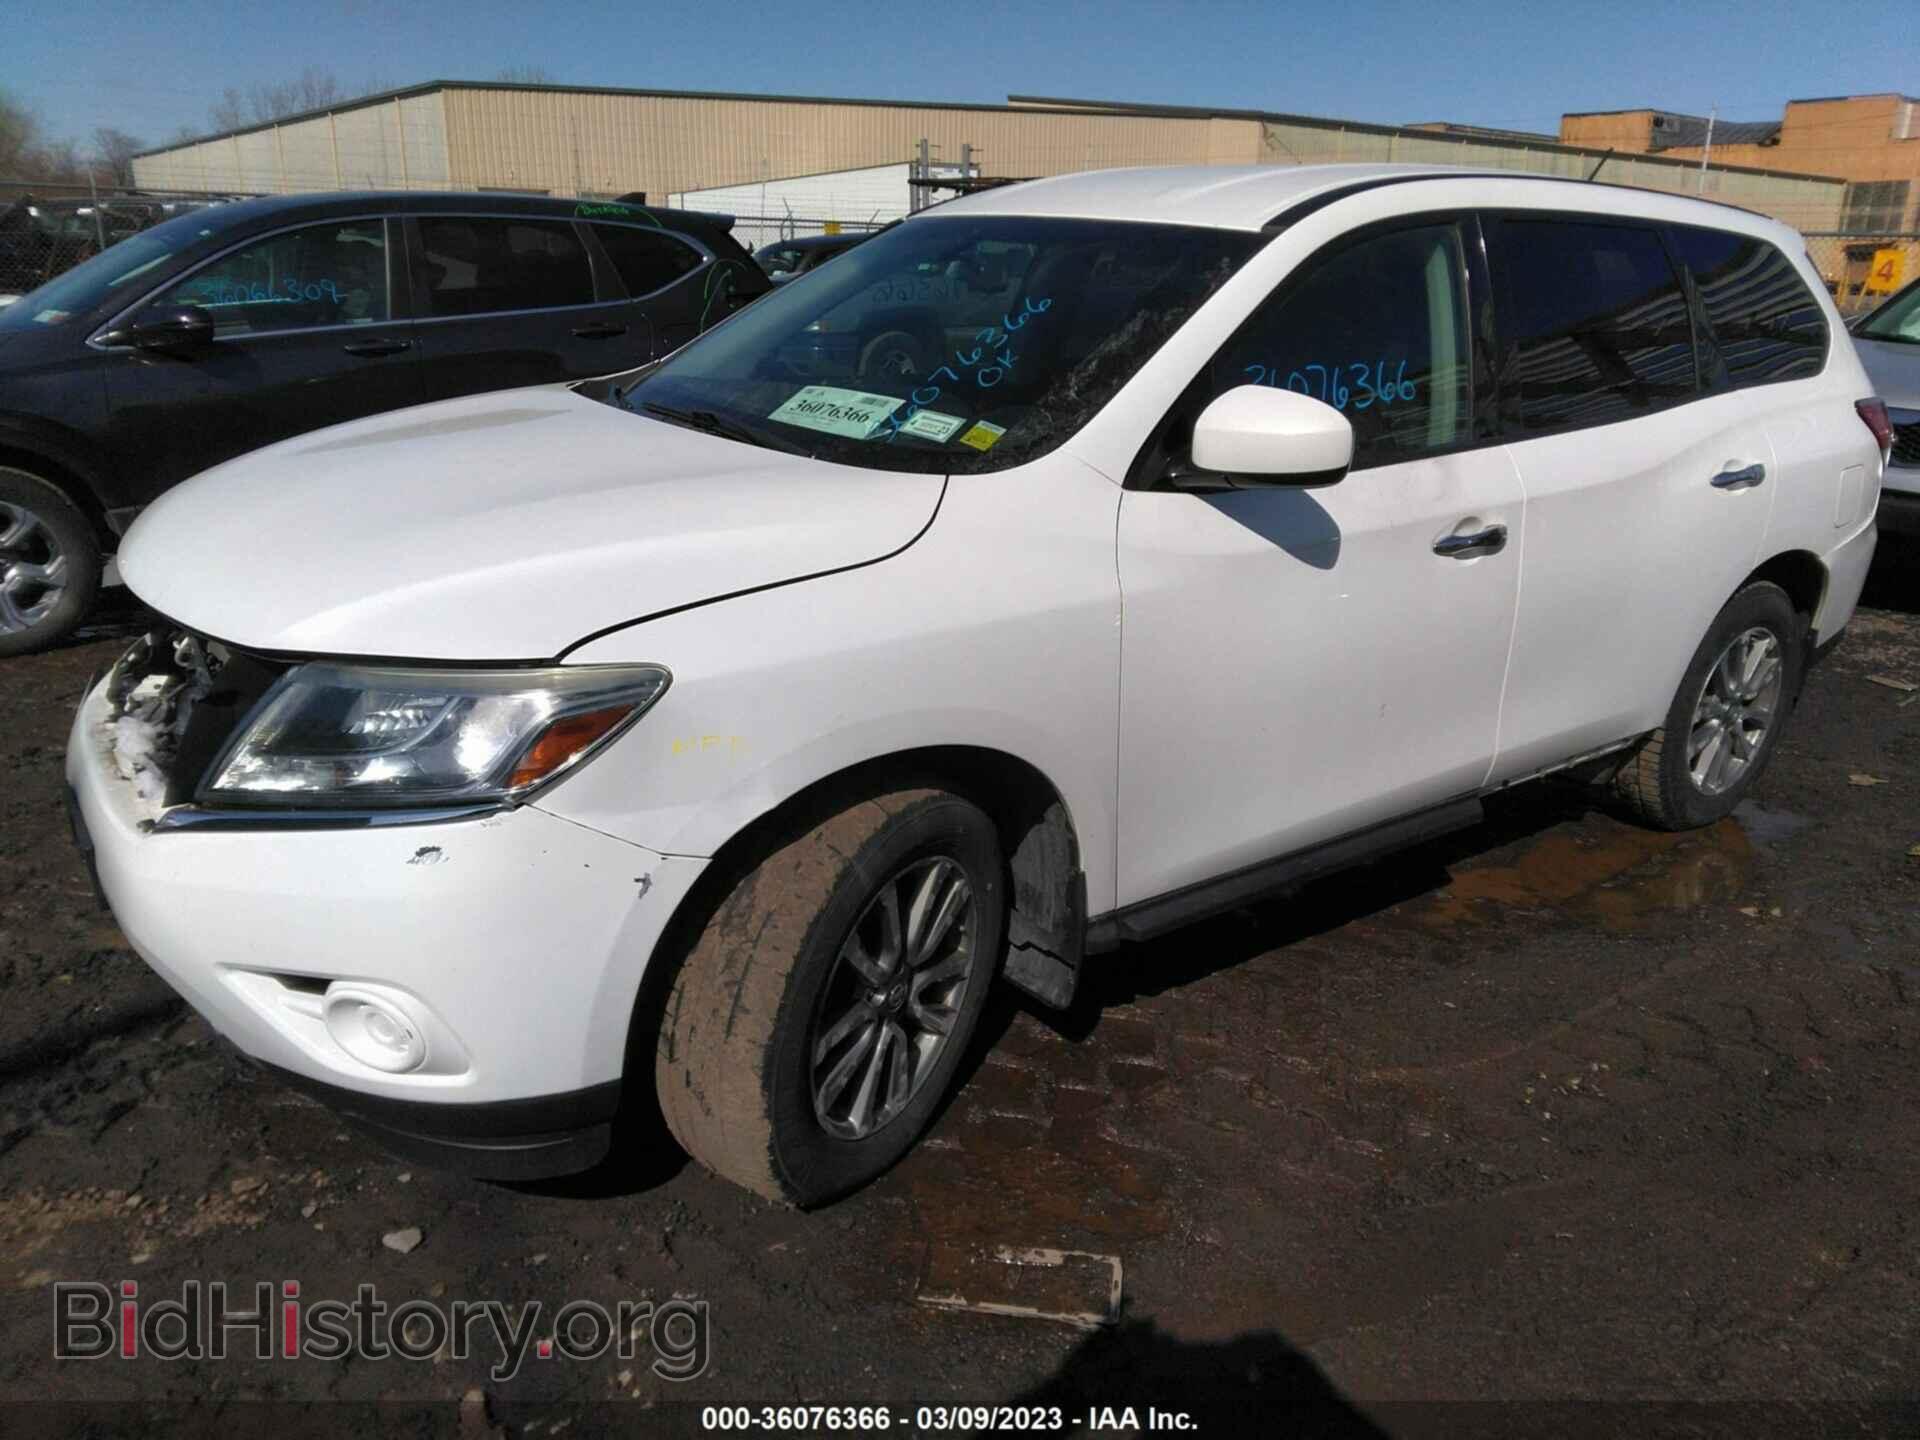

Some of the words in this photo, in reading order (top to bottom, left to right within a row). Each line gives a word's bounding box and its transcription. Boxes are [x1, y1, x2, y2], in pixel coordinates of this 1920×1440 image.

[1877, 259, 1894, 283] 4
[977, 349, 1018, 388] OK
[789, 400, 874, 424] 36076366
